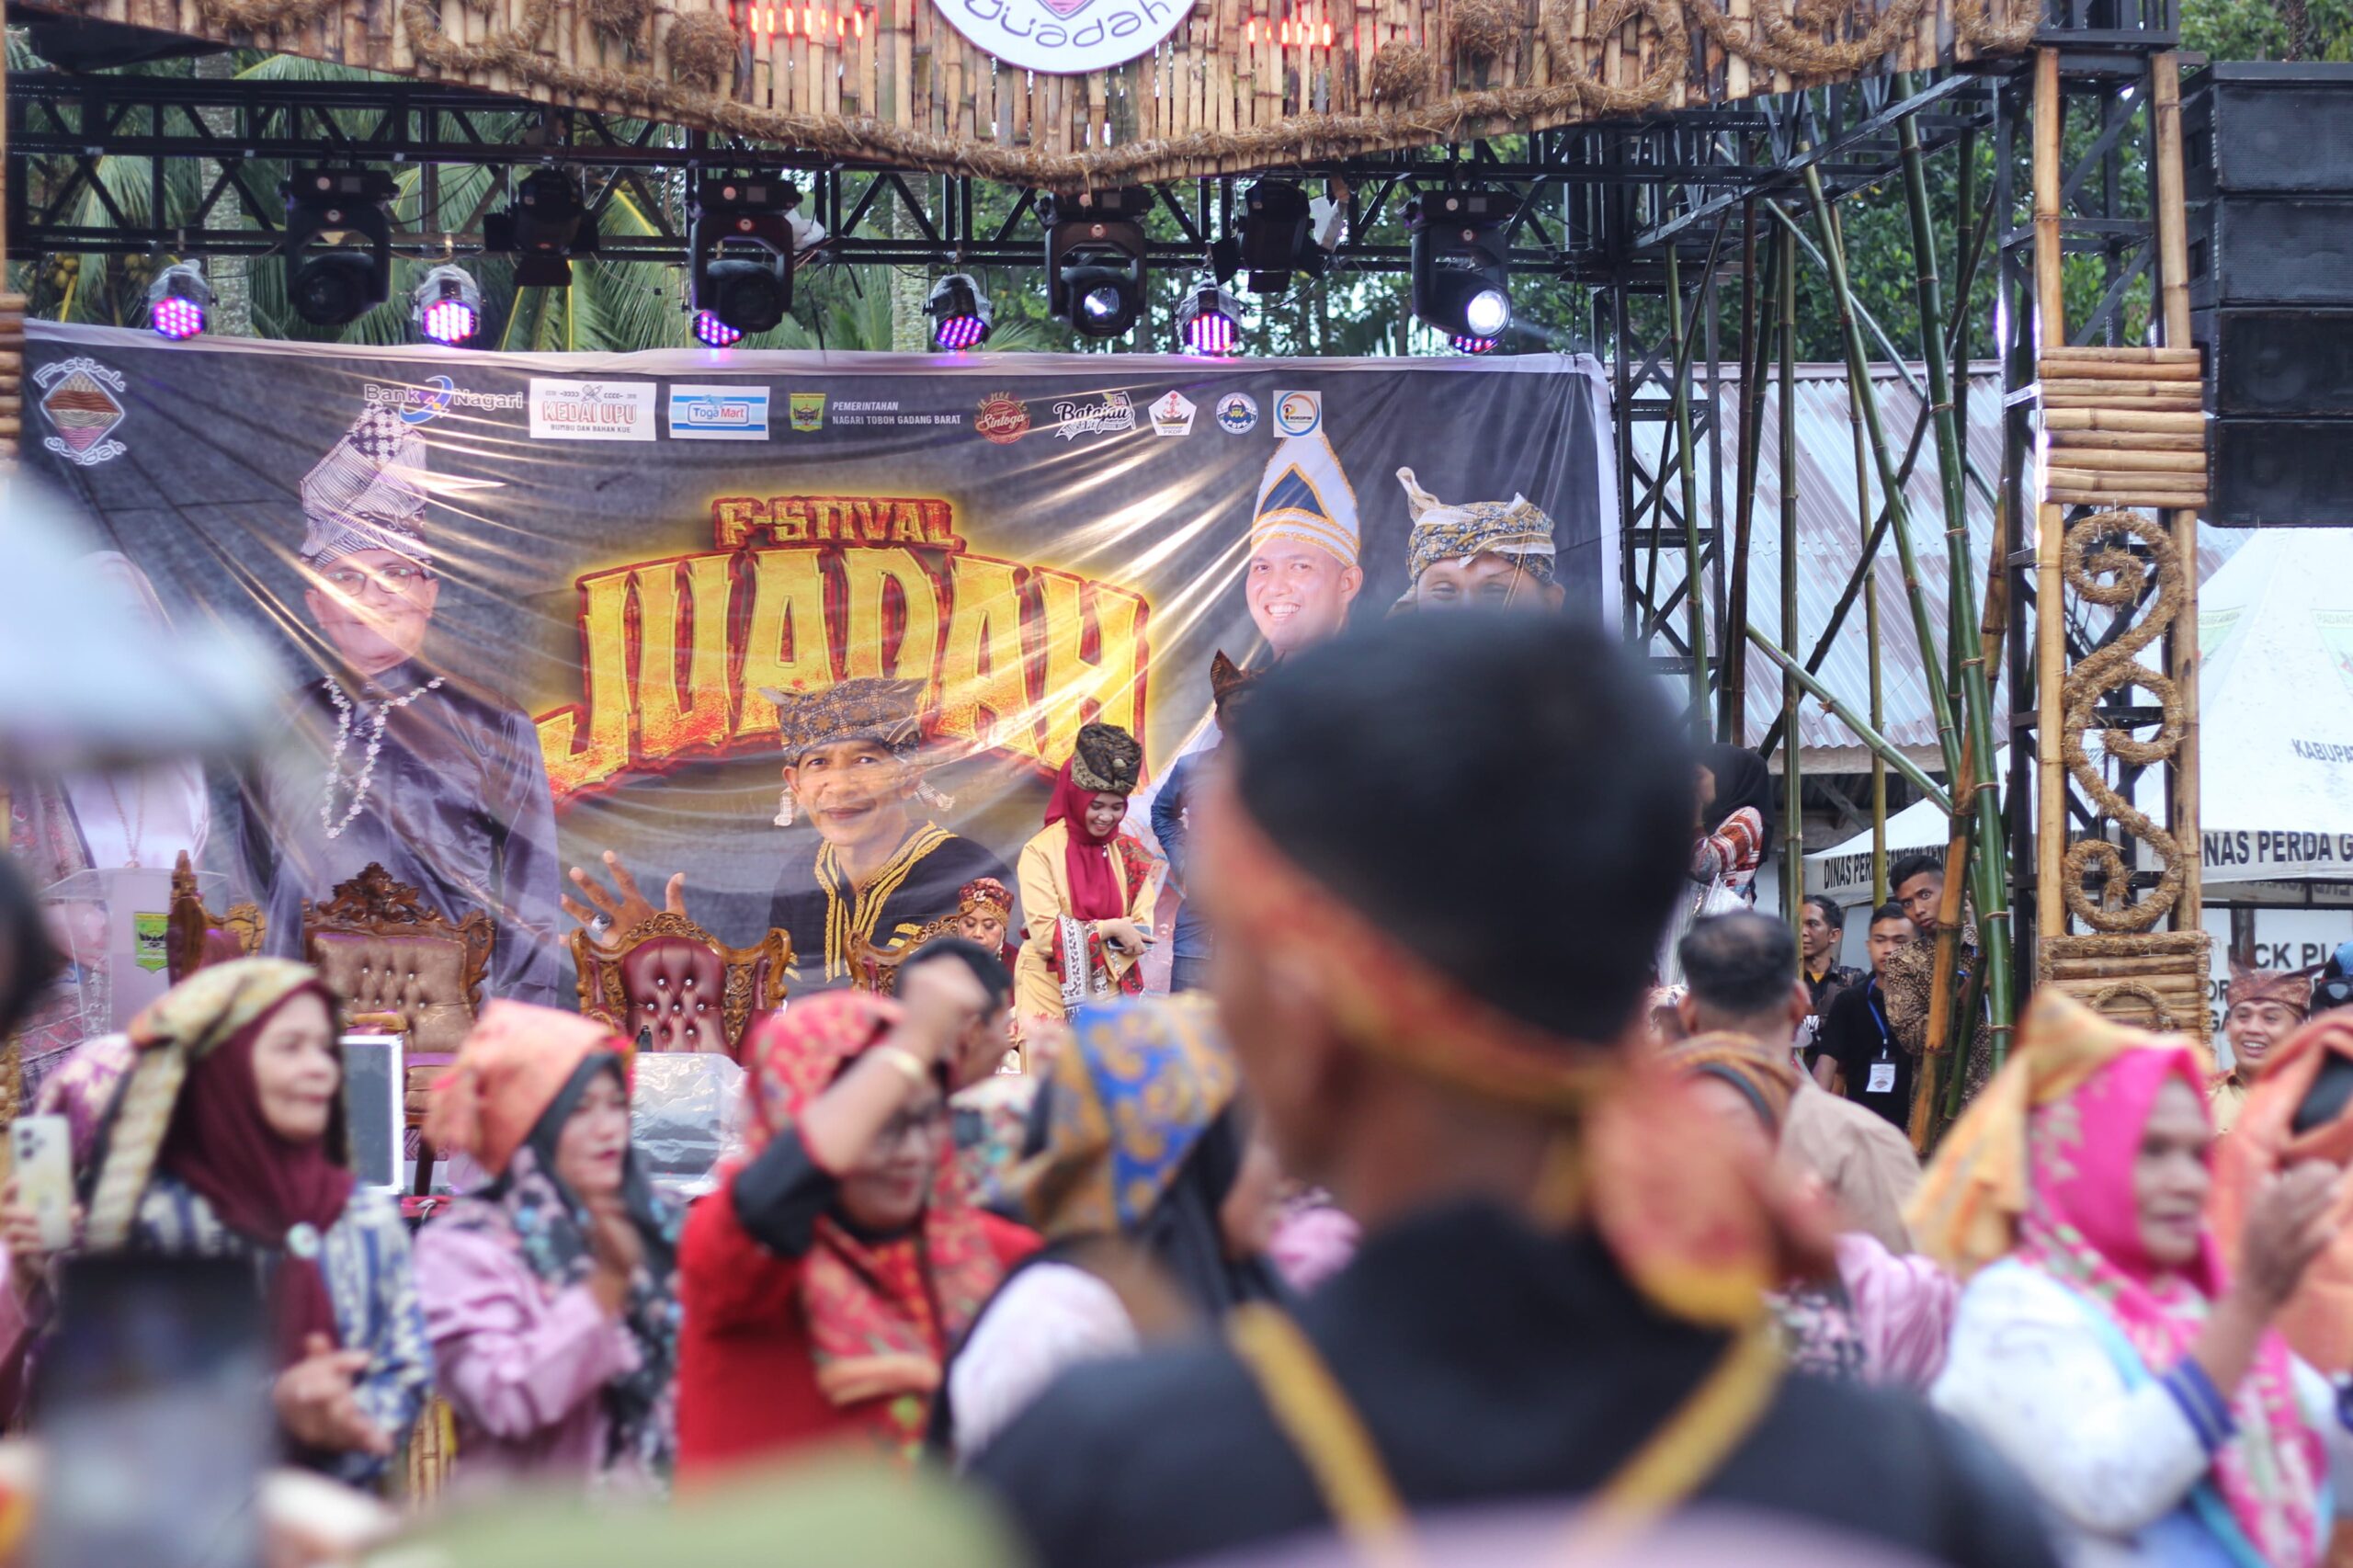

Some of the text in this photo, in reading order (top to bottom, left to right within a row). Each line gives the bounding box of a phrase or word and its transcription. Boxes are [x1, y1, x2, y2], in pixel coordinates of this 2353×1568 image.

[364, 384, 523, 411] Bank Nagari
[832, 402, 899, 411] PEMERINTAHAN
[542, 401, 637, 425] KEDAI UPU
[693, 407, 745, 420] Toga Mart
[832, 415, 961, 425] NAGARI TOBOH GADANG BARAT
[975, 413, 1026, 431] Sintoga
[533, 544, 1145, 807] JUADAH
[1824, 855, 1851, 890] DINAS
